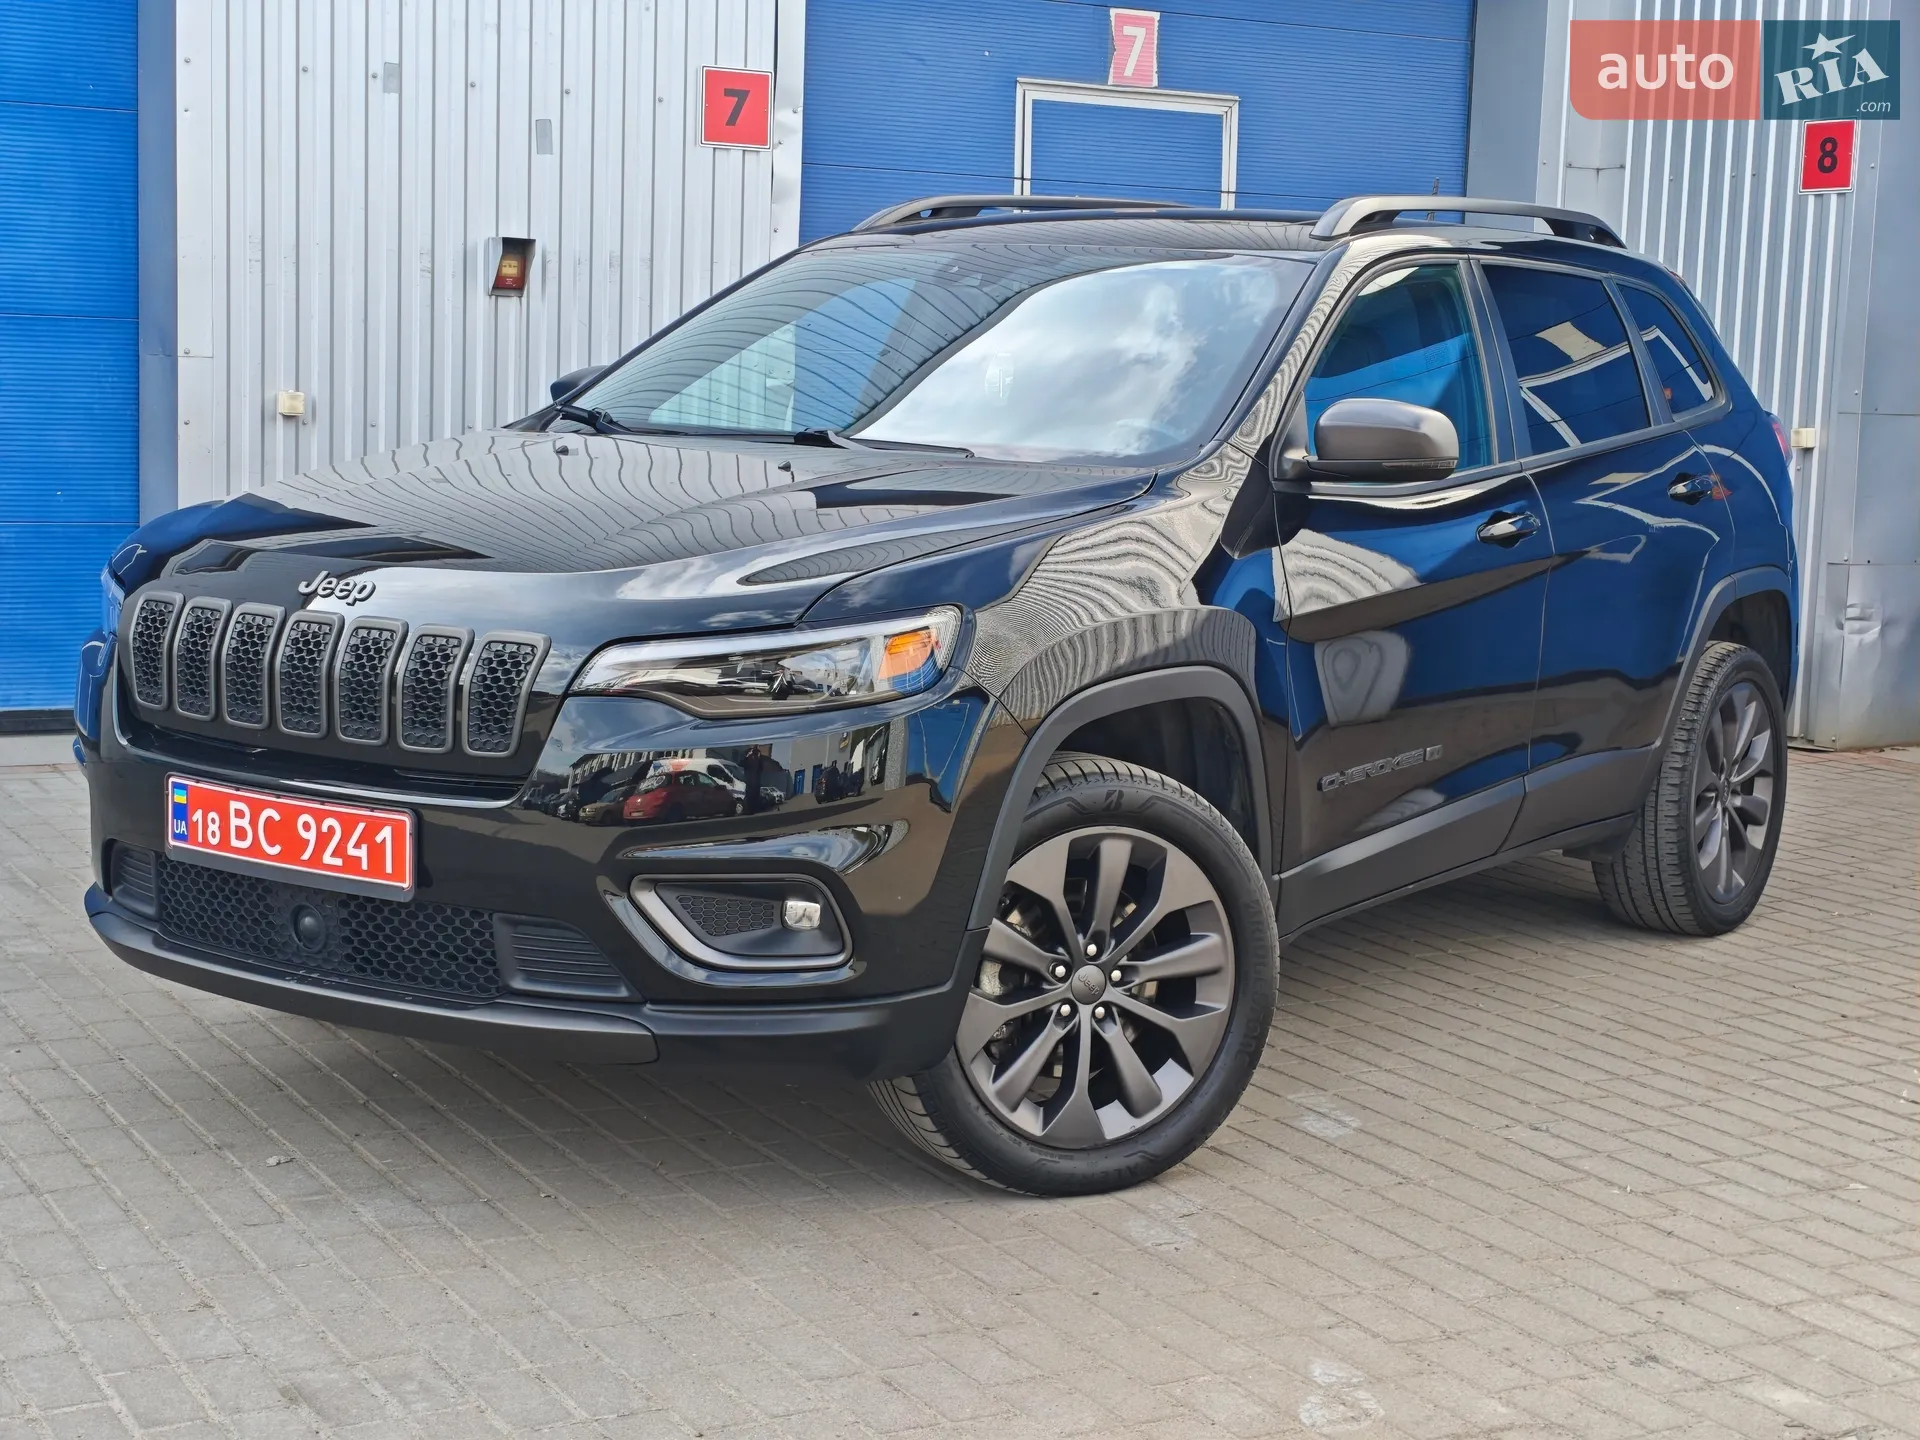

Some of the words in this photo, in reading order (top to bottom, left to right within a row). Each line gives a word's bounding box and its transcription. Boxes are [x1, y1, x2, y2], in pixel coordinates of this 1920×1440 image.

[1122, 26, 1147, 77] 7
[723, 88, 750, 127] 7
[1817, 136, 1838, 174] 8
[298, 570, 376, 607] Jeep
[173, 818, 188, 836] UA
[191, 808, 221, 846] 18
[229, 800, 283, 856] BC
[296, 812, 394, 875] 9241
[1078, 973, 1101, 995] Jeep
